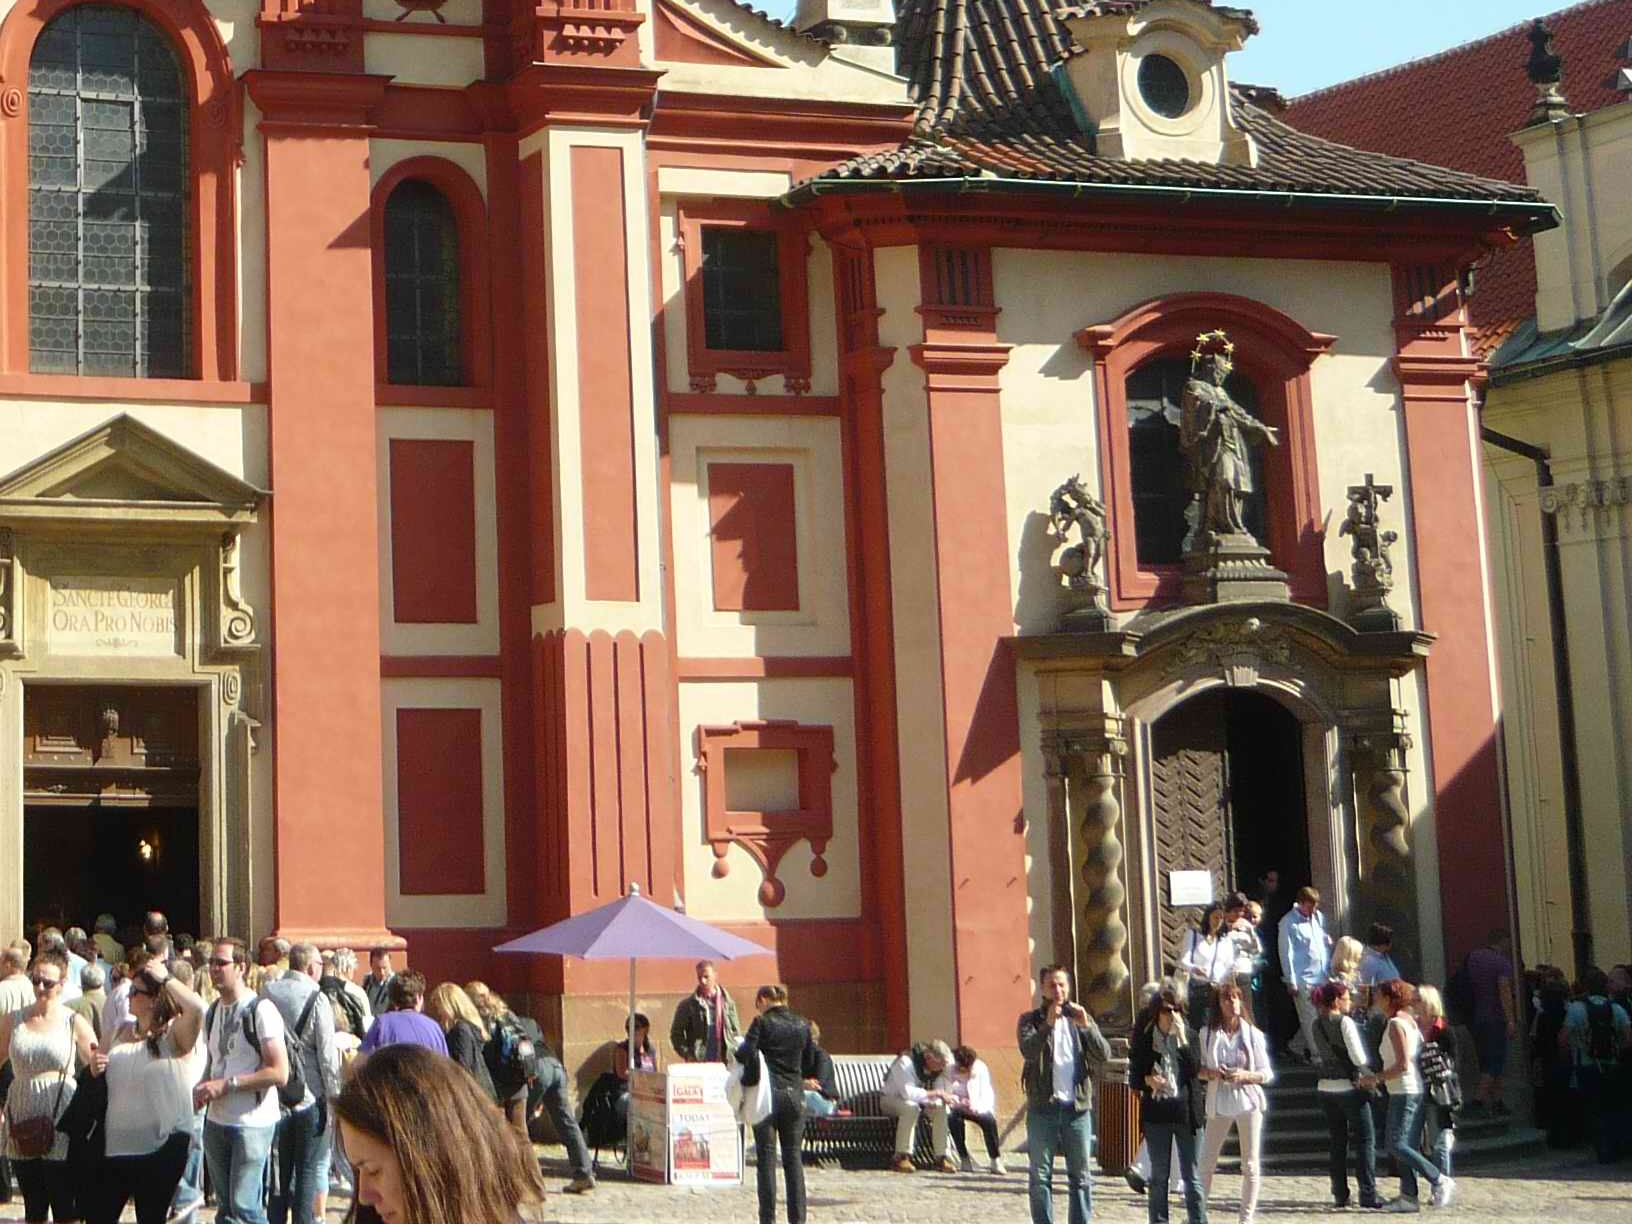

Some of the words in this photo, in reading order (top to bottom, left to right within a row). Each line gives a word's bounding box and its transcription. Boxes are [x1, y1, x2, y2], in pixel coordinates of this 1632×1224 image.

[116, 584, 172, 609] GEORG
[52, 609, 91, 632] ORA
[94, 609, 127, 633] PRO
